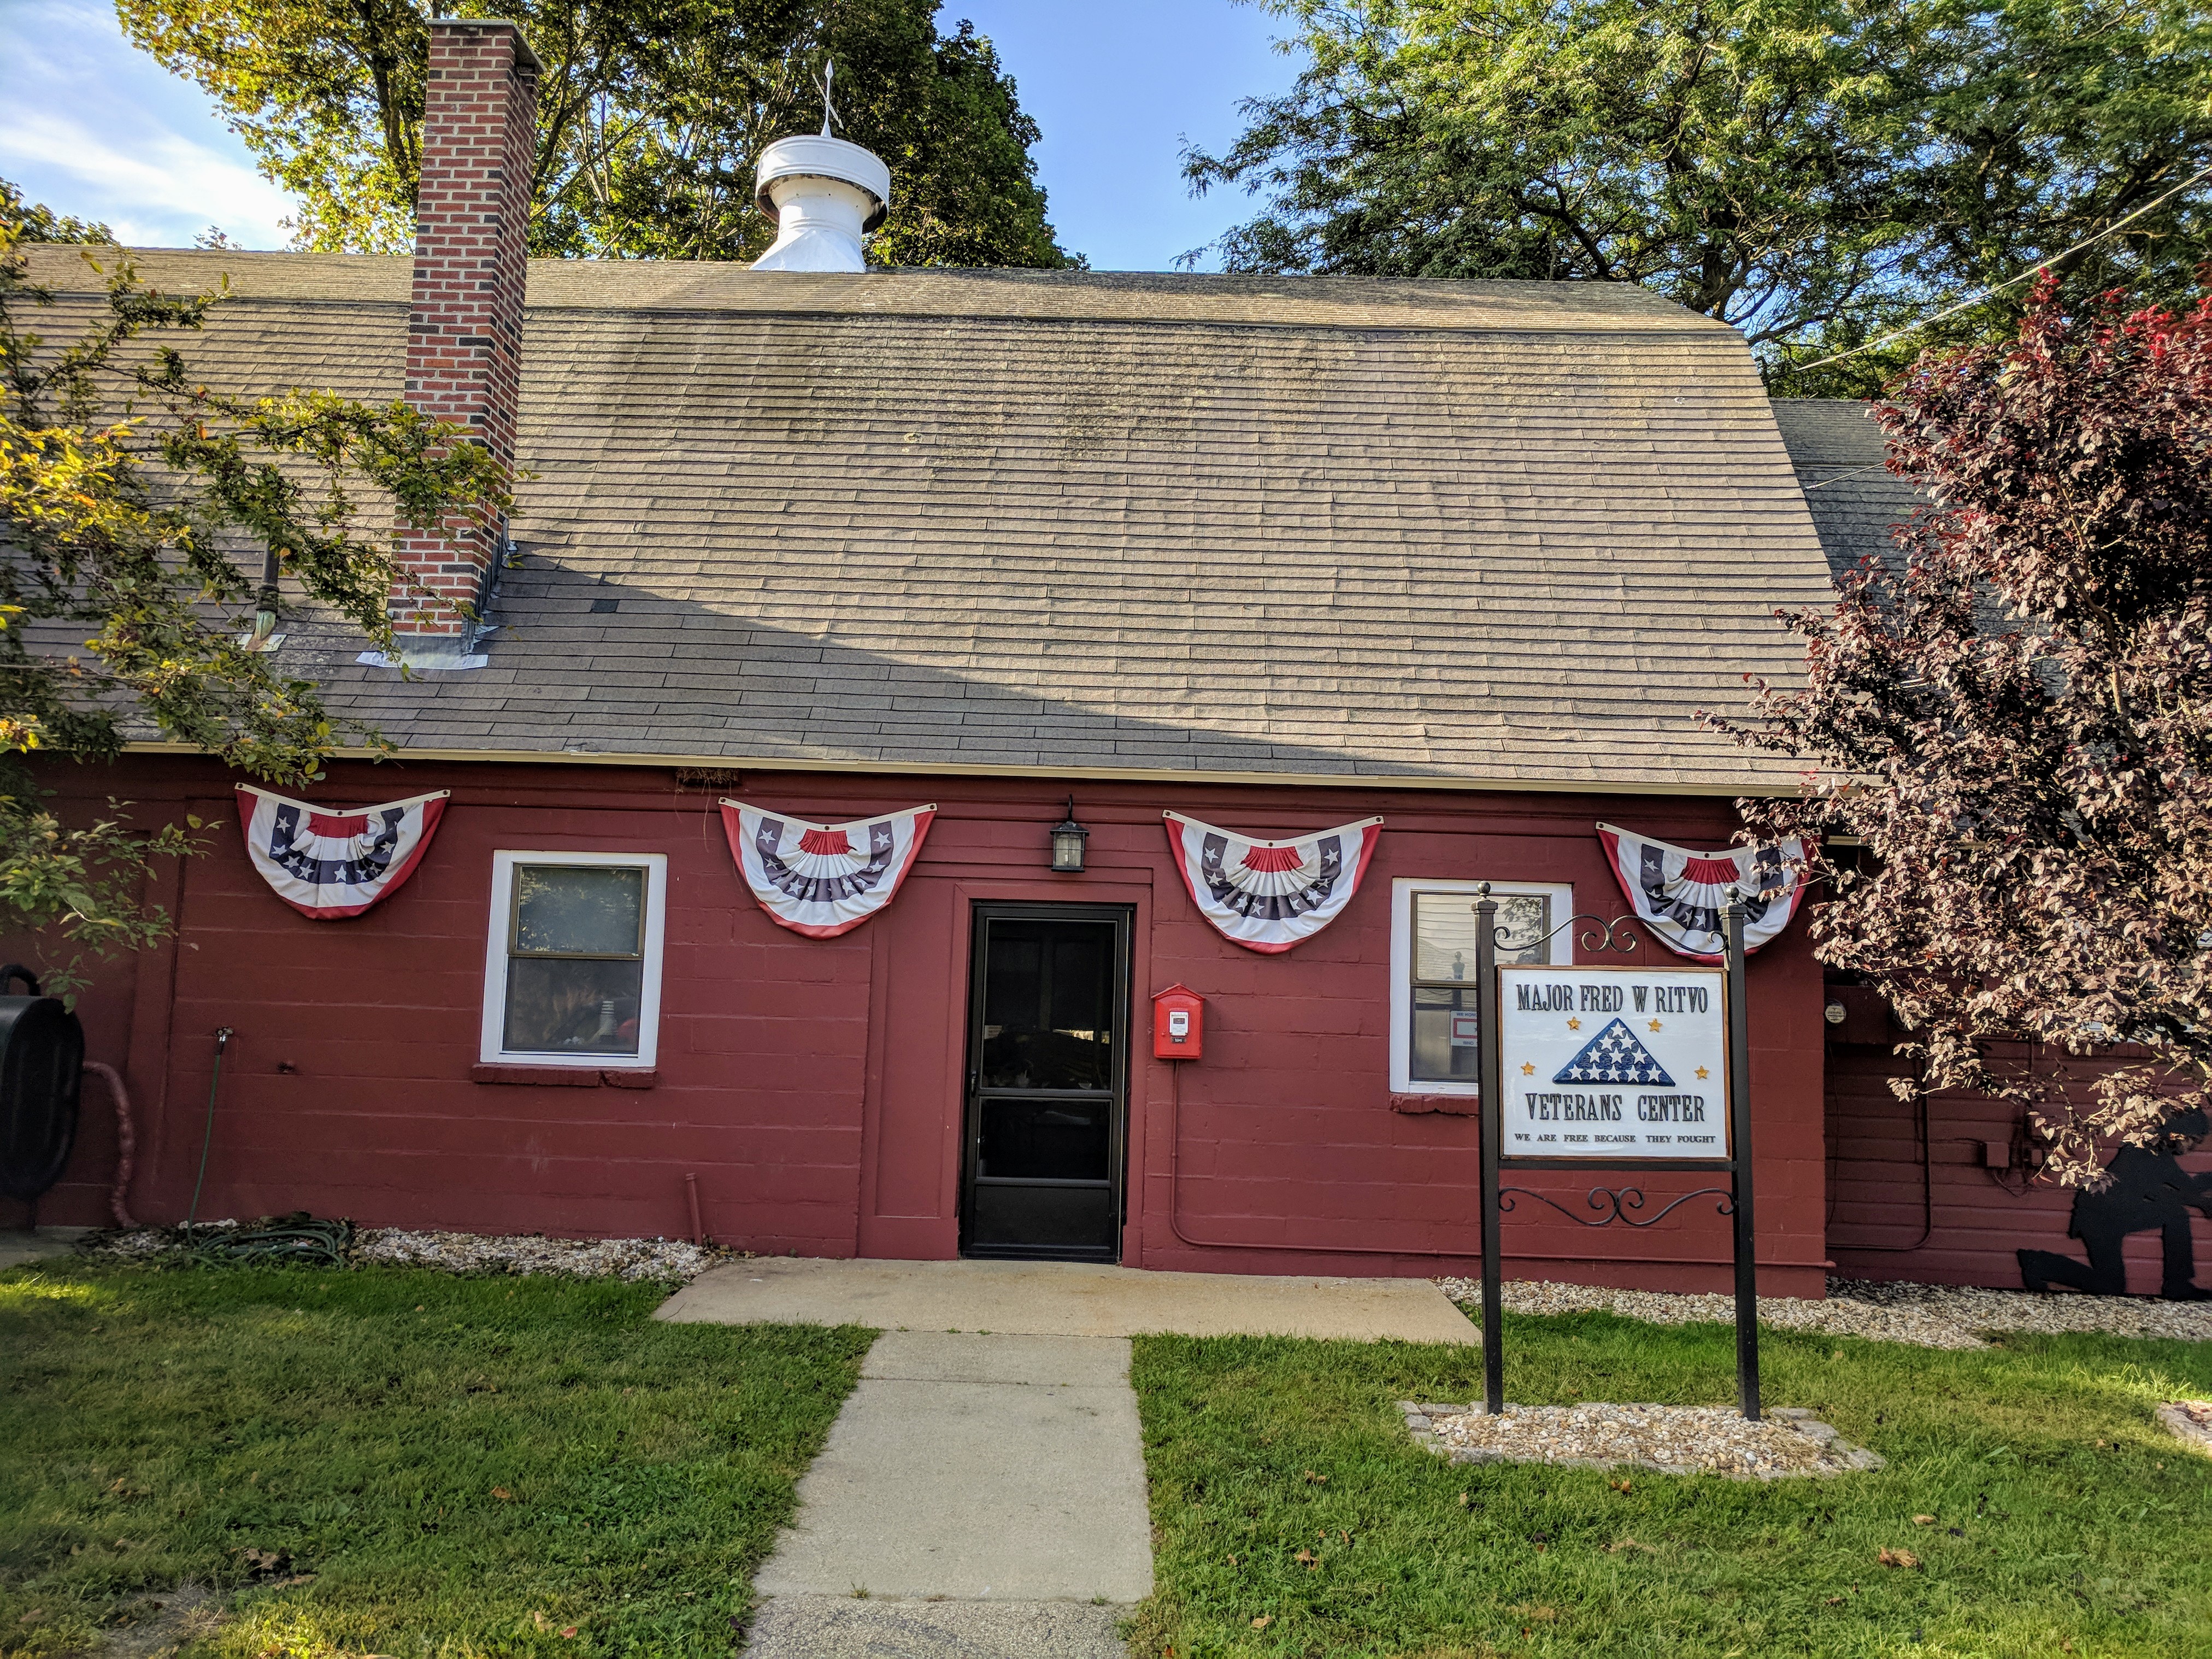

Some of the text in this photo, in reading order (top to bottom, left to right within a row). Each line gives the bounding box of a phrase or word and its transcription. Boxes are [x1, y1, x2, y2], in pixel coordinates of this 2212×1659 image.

[1516, 984, 1708, 1013] MAJOR FRED W RITVO
[1525, 1093, 1705, 1121] VETERANS CENTER
[1595, 1134, 1636, 1143] BECAUSE
[1677, 1135, 1715, 1143] FOUGHT
